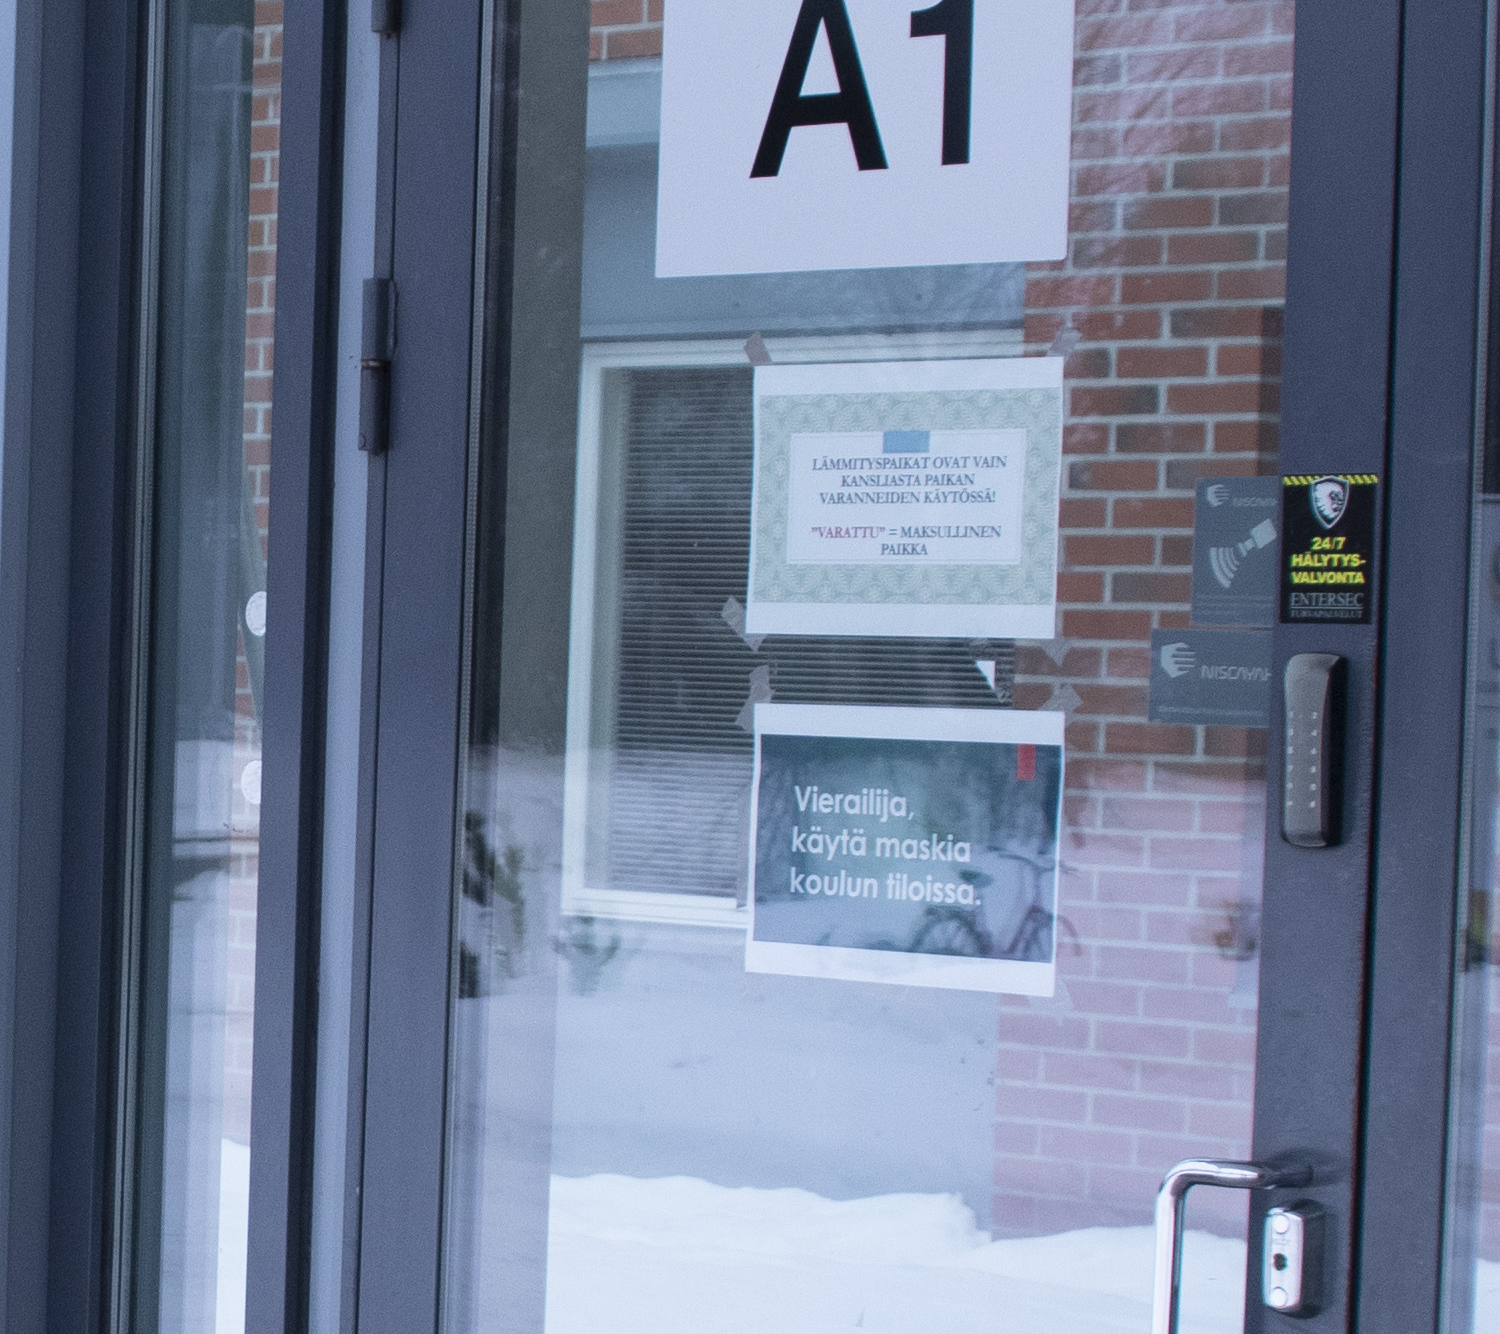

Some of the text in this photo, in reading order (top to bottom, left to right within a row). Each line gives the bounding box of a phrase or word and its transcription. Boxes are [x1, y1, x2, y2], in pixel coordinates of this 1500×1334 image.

[812, 455, 1008, 471] LÄMMITYSPAIKAT OVAT VAIN
[841, 472, 976, 488] KANSLIASTA PAIKAN
[819, 487, 997, 505] VARANNEIDEN KÄYTÖSSÄ!
[900, 525, 1003, 539] MAKSULLINEN
[880, 542, 929, 557] PAIKKA
[1311, 536, 1347, 550] 24/7
[1291, 551, 1367, 567] HÄLYTYS-
[1291, 571, 1366, 584] VALVONTA
[1290, 592, 1364, 606] ENTERSEC
[794, 785, 915, 823] Vierailija,
[791, 825, 972, 863] käytä maskia
[790, 866, 982, 905] koulun tiloissa.
